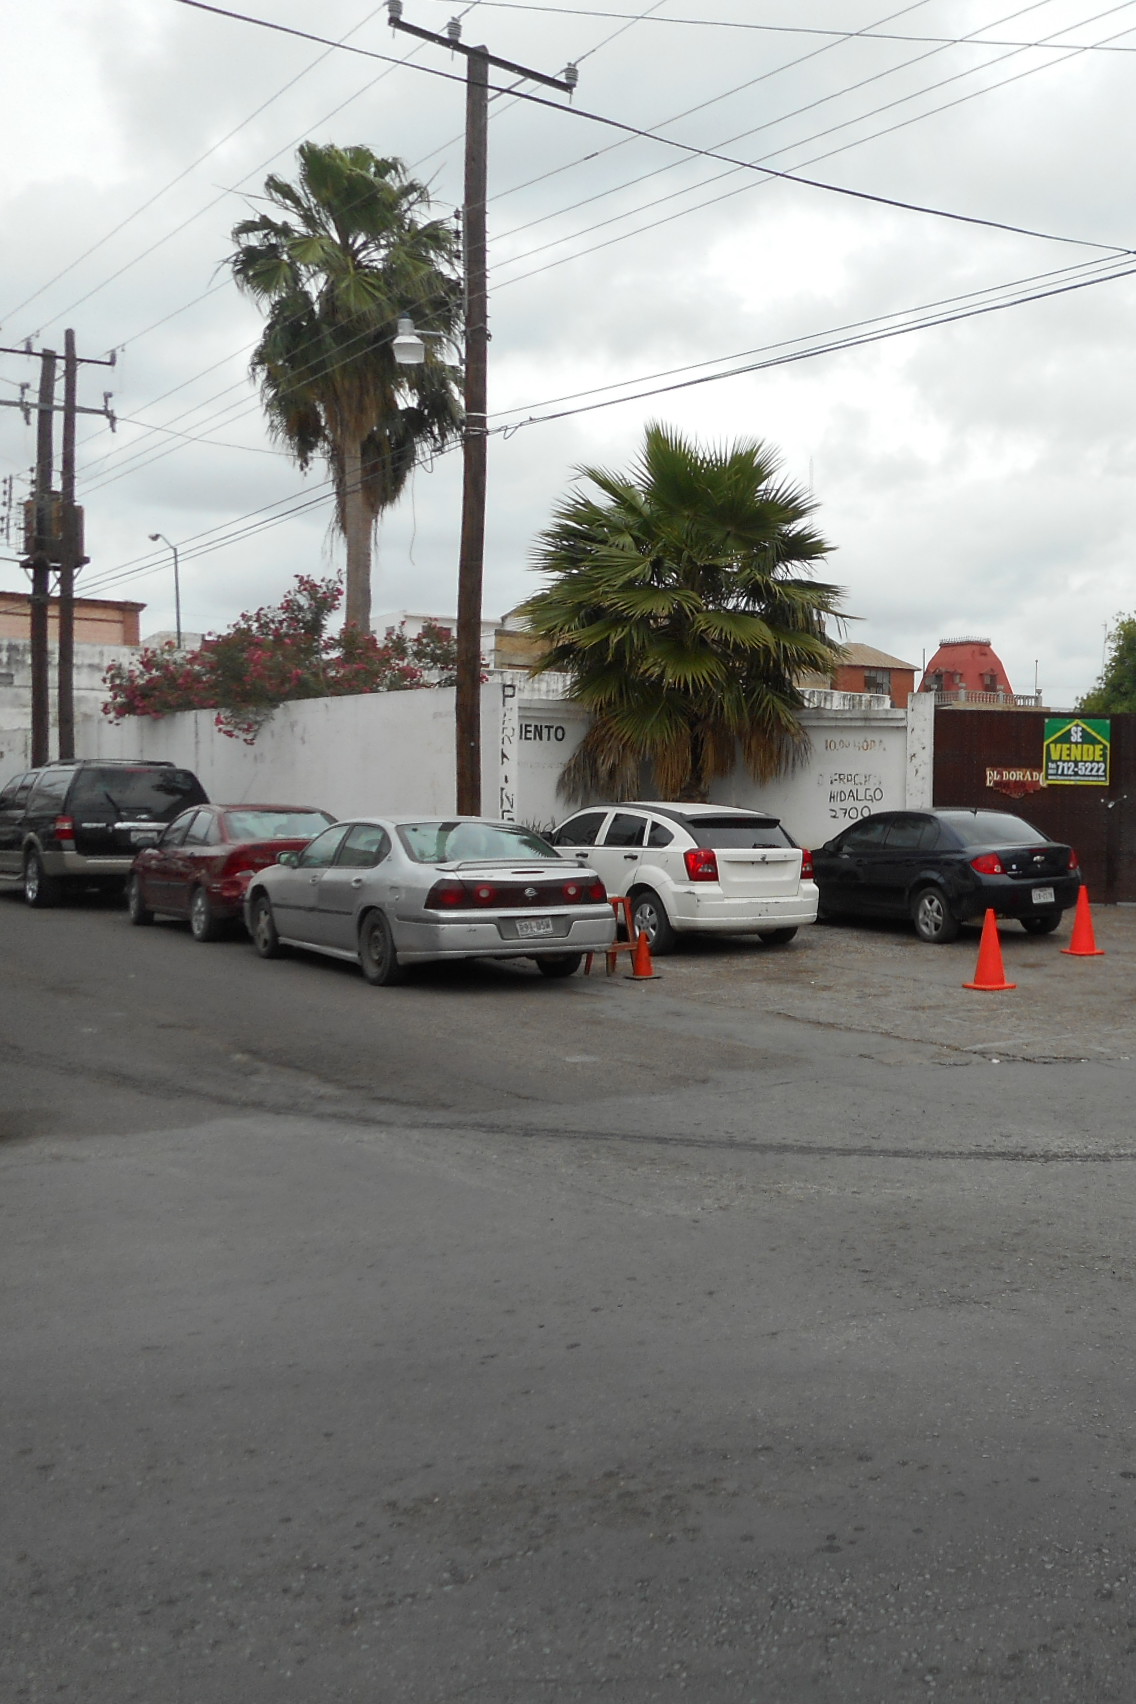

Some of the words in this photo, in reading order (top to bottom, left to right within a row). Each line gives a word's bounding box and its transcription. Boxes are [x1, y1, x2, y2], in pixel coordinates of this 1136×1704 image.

[519, 723, 565, 742] IENTO
[1070, 726, 1083, 742] SE
[1050, 744, 1103, 761] VENDE
[1057, 762, 1105, 776] 712-5222
[986, 770, 1000, 787] EL
[829, 787, 884, 803] HIDALGO
[829, 805, 872, 820] 2700
